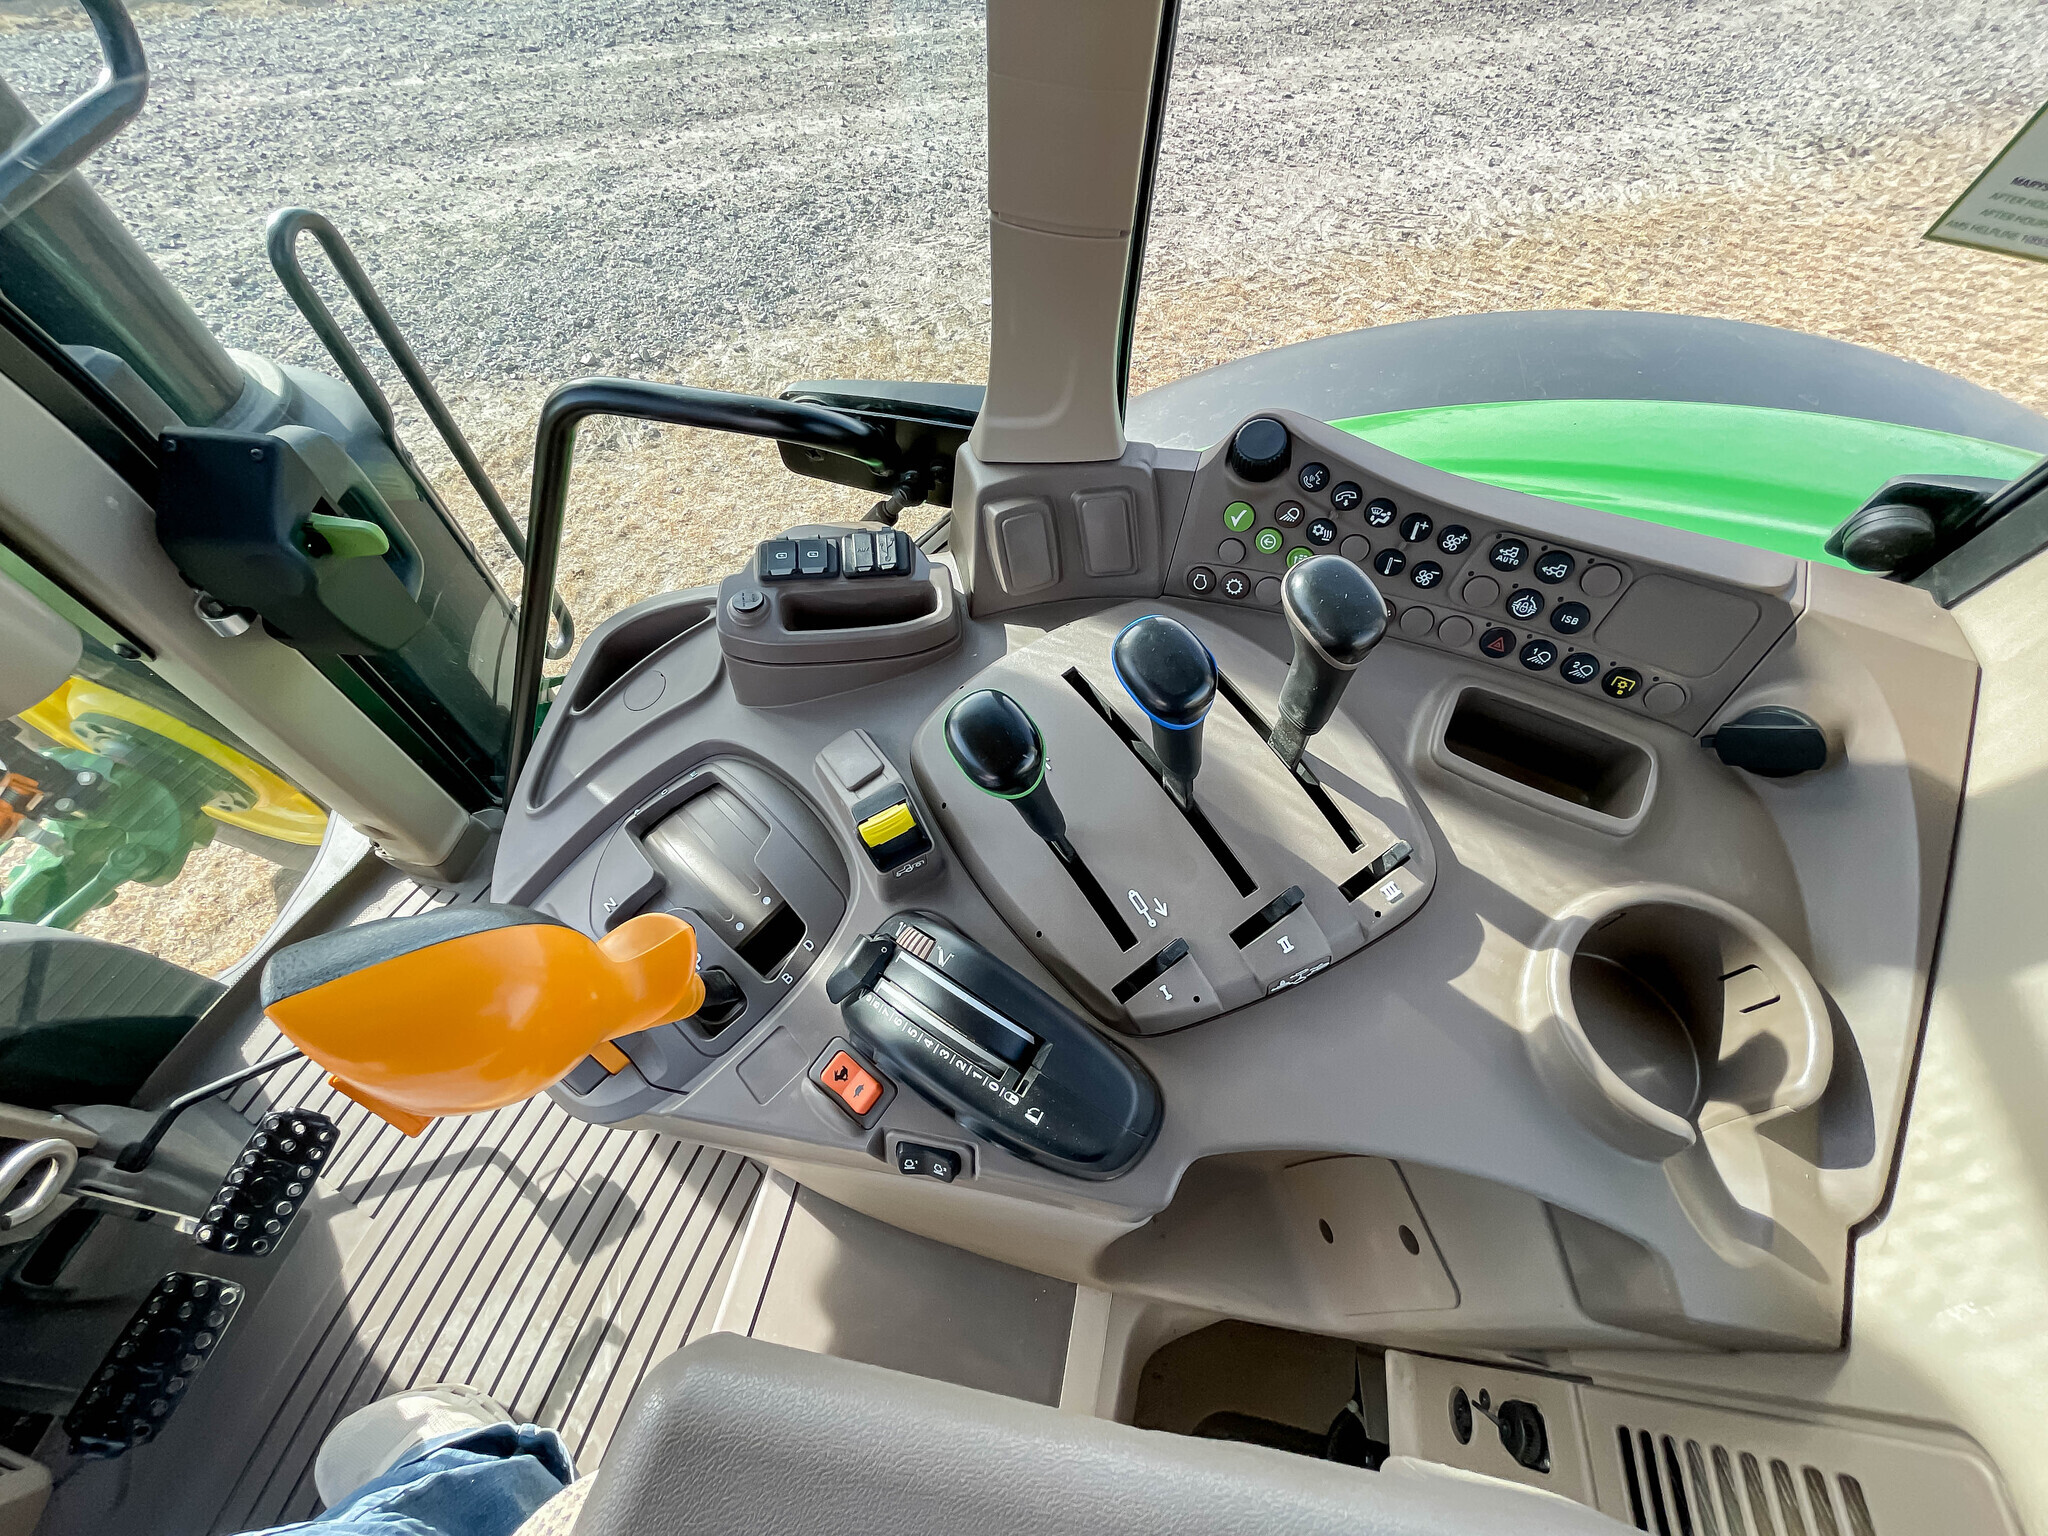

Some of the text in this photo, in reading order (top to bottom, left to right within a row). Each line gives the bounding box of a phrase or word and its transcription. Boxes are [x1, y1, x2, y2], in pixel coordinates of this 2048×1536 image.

[1496, 555, 1519, 566] AUTO
[1560, 614, 1579, 625] ISB
[1533, 647, 1539, 655] 1
[1572, 661, 1580, 669] 2
[603, 896, 618, 913] N
[803, 939, 815, 952] D
[781, 972, 794, 985] B
[894, 1017, 903, 1027] 6
[907, 1026, 918, 1038] 5
[924, 1038, 934, 1048] 4
[939, 1048, 950, 1060] 3
[955, 1060, 967, 1071] 2
[972, 1070, 983, 1080] 1
[988, 1081, 1000, 1092] 0
